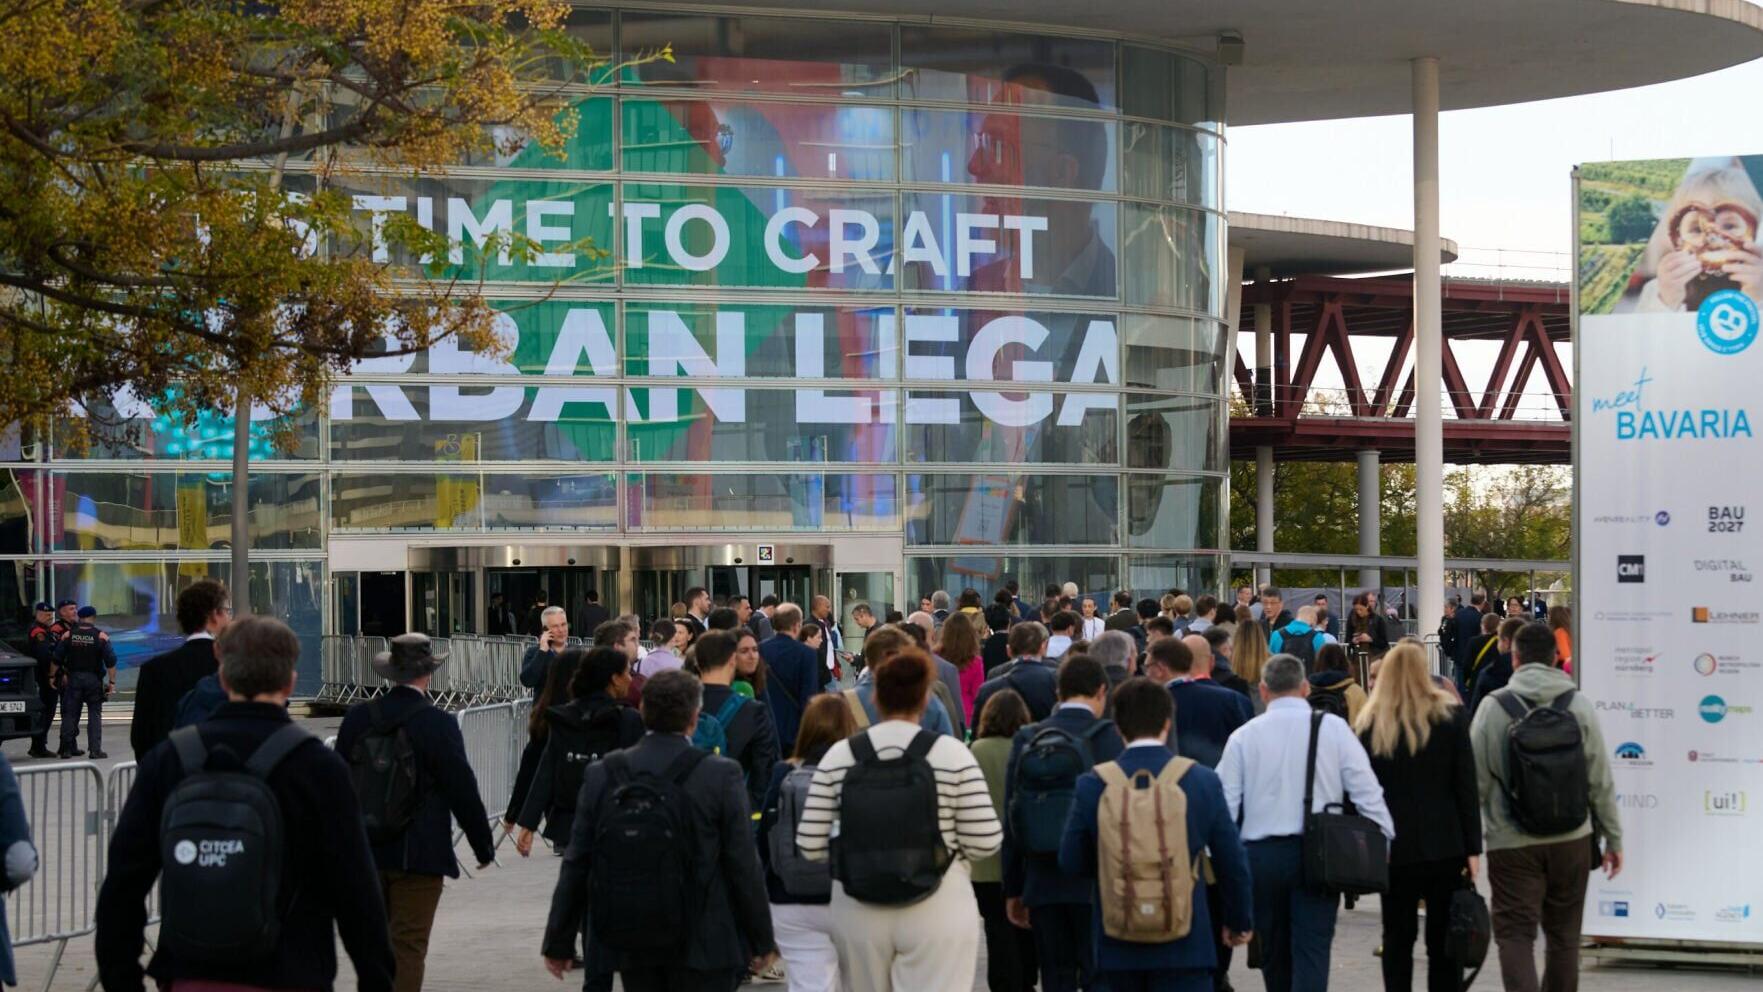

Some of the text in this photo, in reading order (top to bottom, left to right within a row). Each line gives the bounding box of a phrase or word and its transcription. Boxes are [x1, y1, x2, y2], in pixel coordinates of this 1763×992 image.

[352, 196, 576, 268] TIME
[609, 203, 730, 271] TO
[764, 207, 1048, 280] CRAFT
[795, 312, 1118, 427] LEGA
[1593, 366, 1653, 414] meet
[1617, 409, 1752, 440] BAVARIA
[1708, 506, 1744, 520] BAU
[1708, 521, 1744, 533] 2027
[1694, 560, 1747, 571] DIGITAL
[1630, 708, 1675, 719] BETTER
